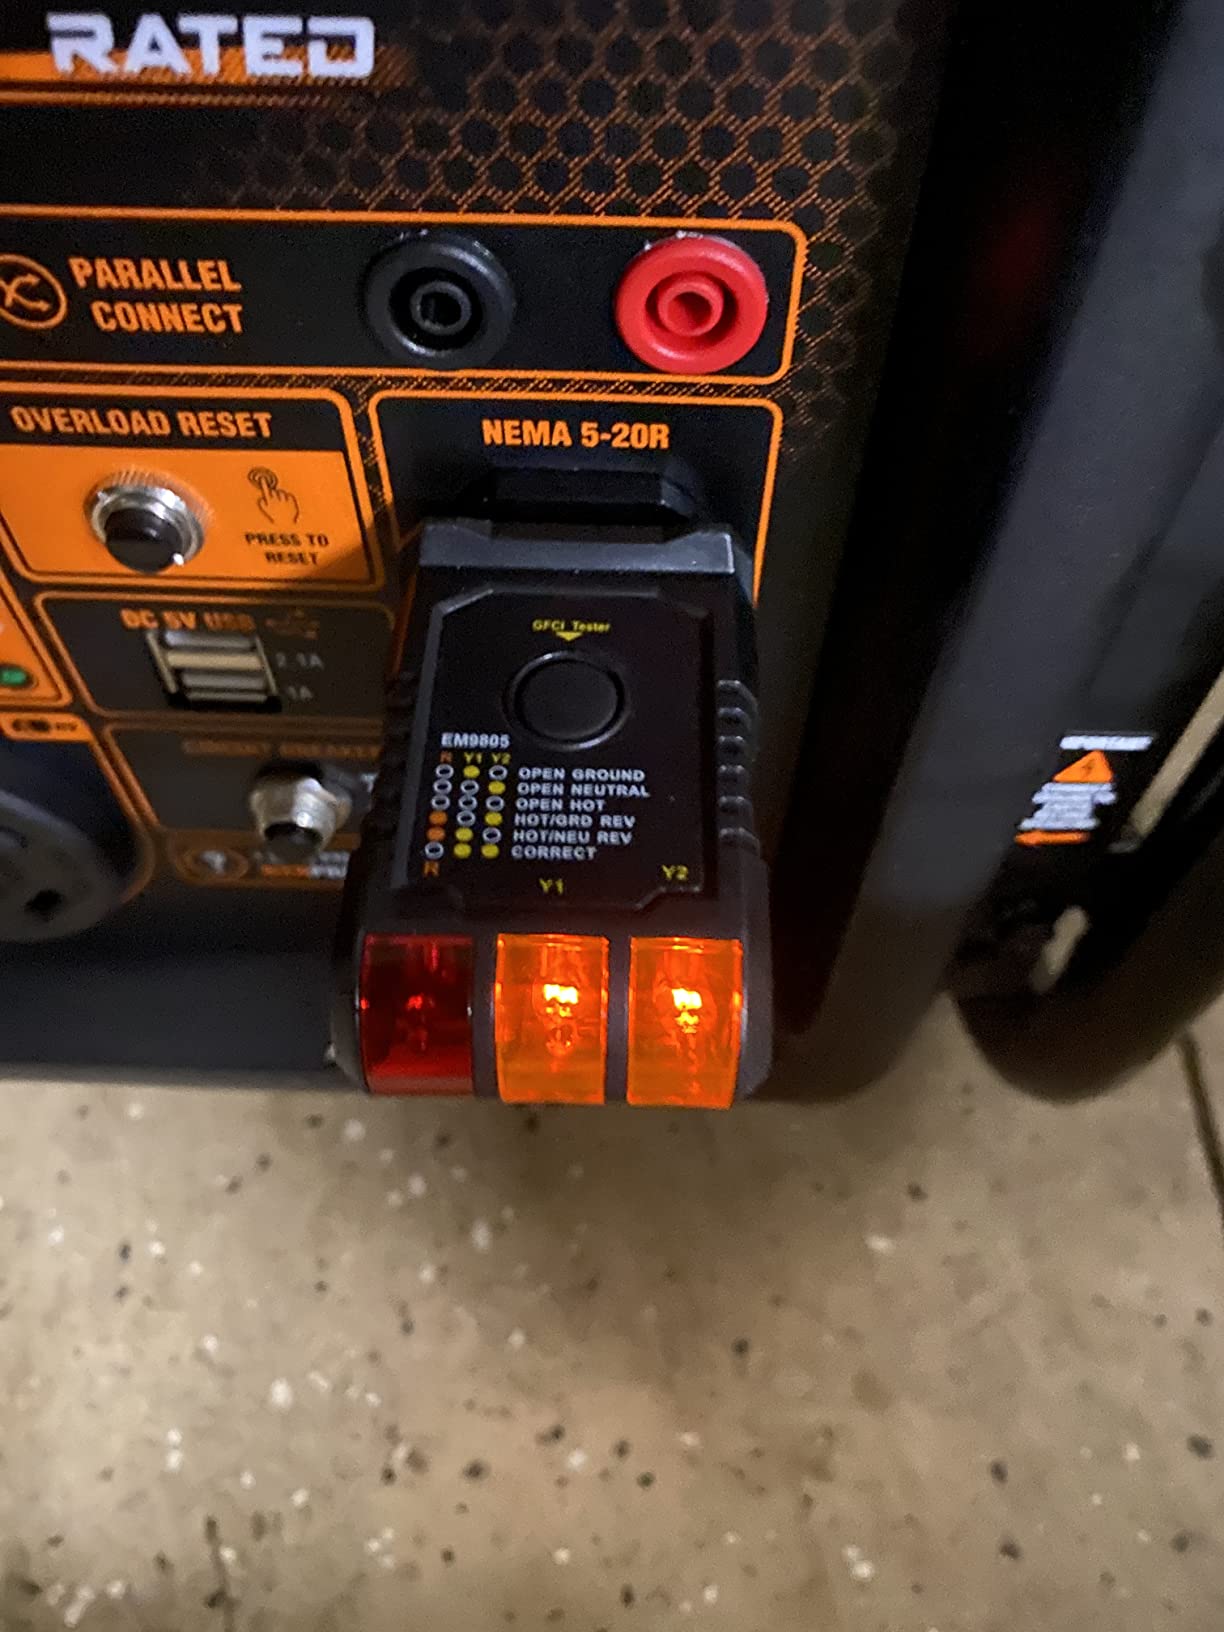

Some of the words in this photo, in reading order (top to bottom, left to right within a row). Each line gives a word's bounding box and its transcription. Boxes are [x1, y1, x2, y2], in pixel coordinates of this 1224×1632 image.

[47, 13, 376, 79] RATED
[69, 257, 242, 292] PARALLEL
[90, 300, 243, 335] CONNECT
[10, 405, 172, 437] OVERLOAD
[176, 411, 273, 438] RESET
[481, 418, 573, 447] NEMA
[580, 421, 670, 450] 5-20R
[245, 532, 302, 546] PRESS
[306, 533, 329, 547] TO
[265, 551, 319, 566] RESET
[120, 608, 159, 631] DC
[532, 619, 565, 632] GFCI
[572, 620, 610, 633] Tester
[440, 732, 511, 748] EM9805
[463, 752, 483, 764] Y1
[491, 753, 511, 765] Y2
[518, 767, 566, 780] OPEN
[572, 768, 645, 782] GROUND
[517, 782, 564, 795] OPEN
[570, 784, 650, 798] NEUTRAL
[515, 798, 563, 811] OPEN
[569, 799, 606, 811] HOT
[514, 813, 593, 827] HOT/GRD
[600, 815, 636, 828] REV
[512, 829, 591, 843] HOT/NEU
[597, 830, 632, 845] REV
[511, 845, 598, 860] CORRECT
[539, 878, 565, 893] Y1
[662, 864, 690, 881] Y2
